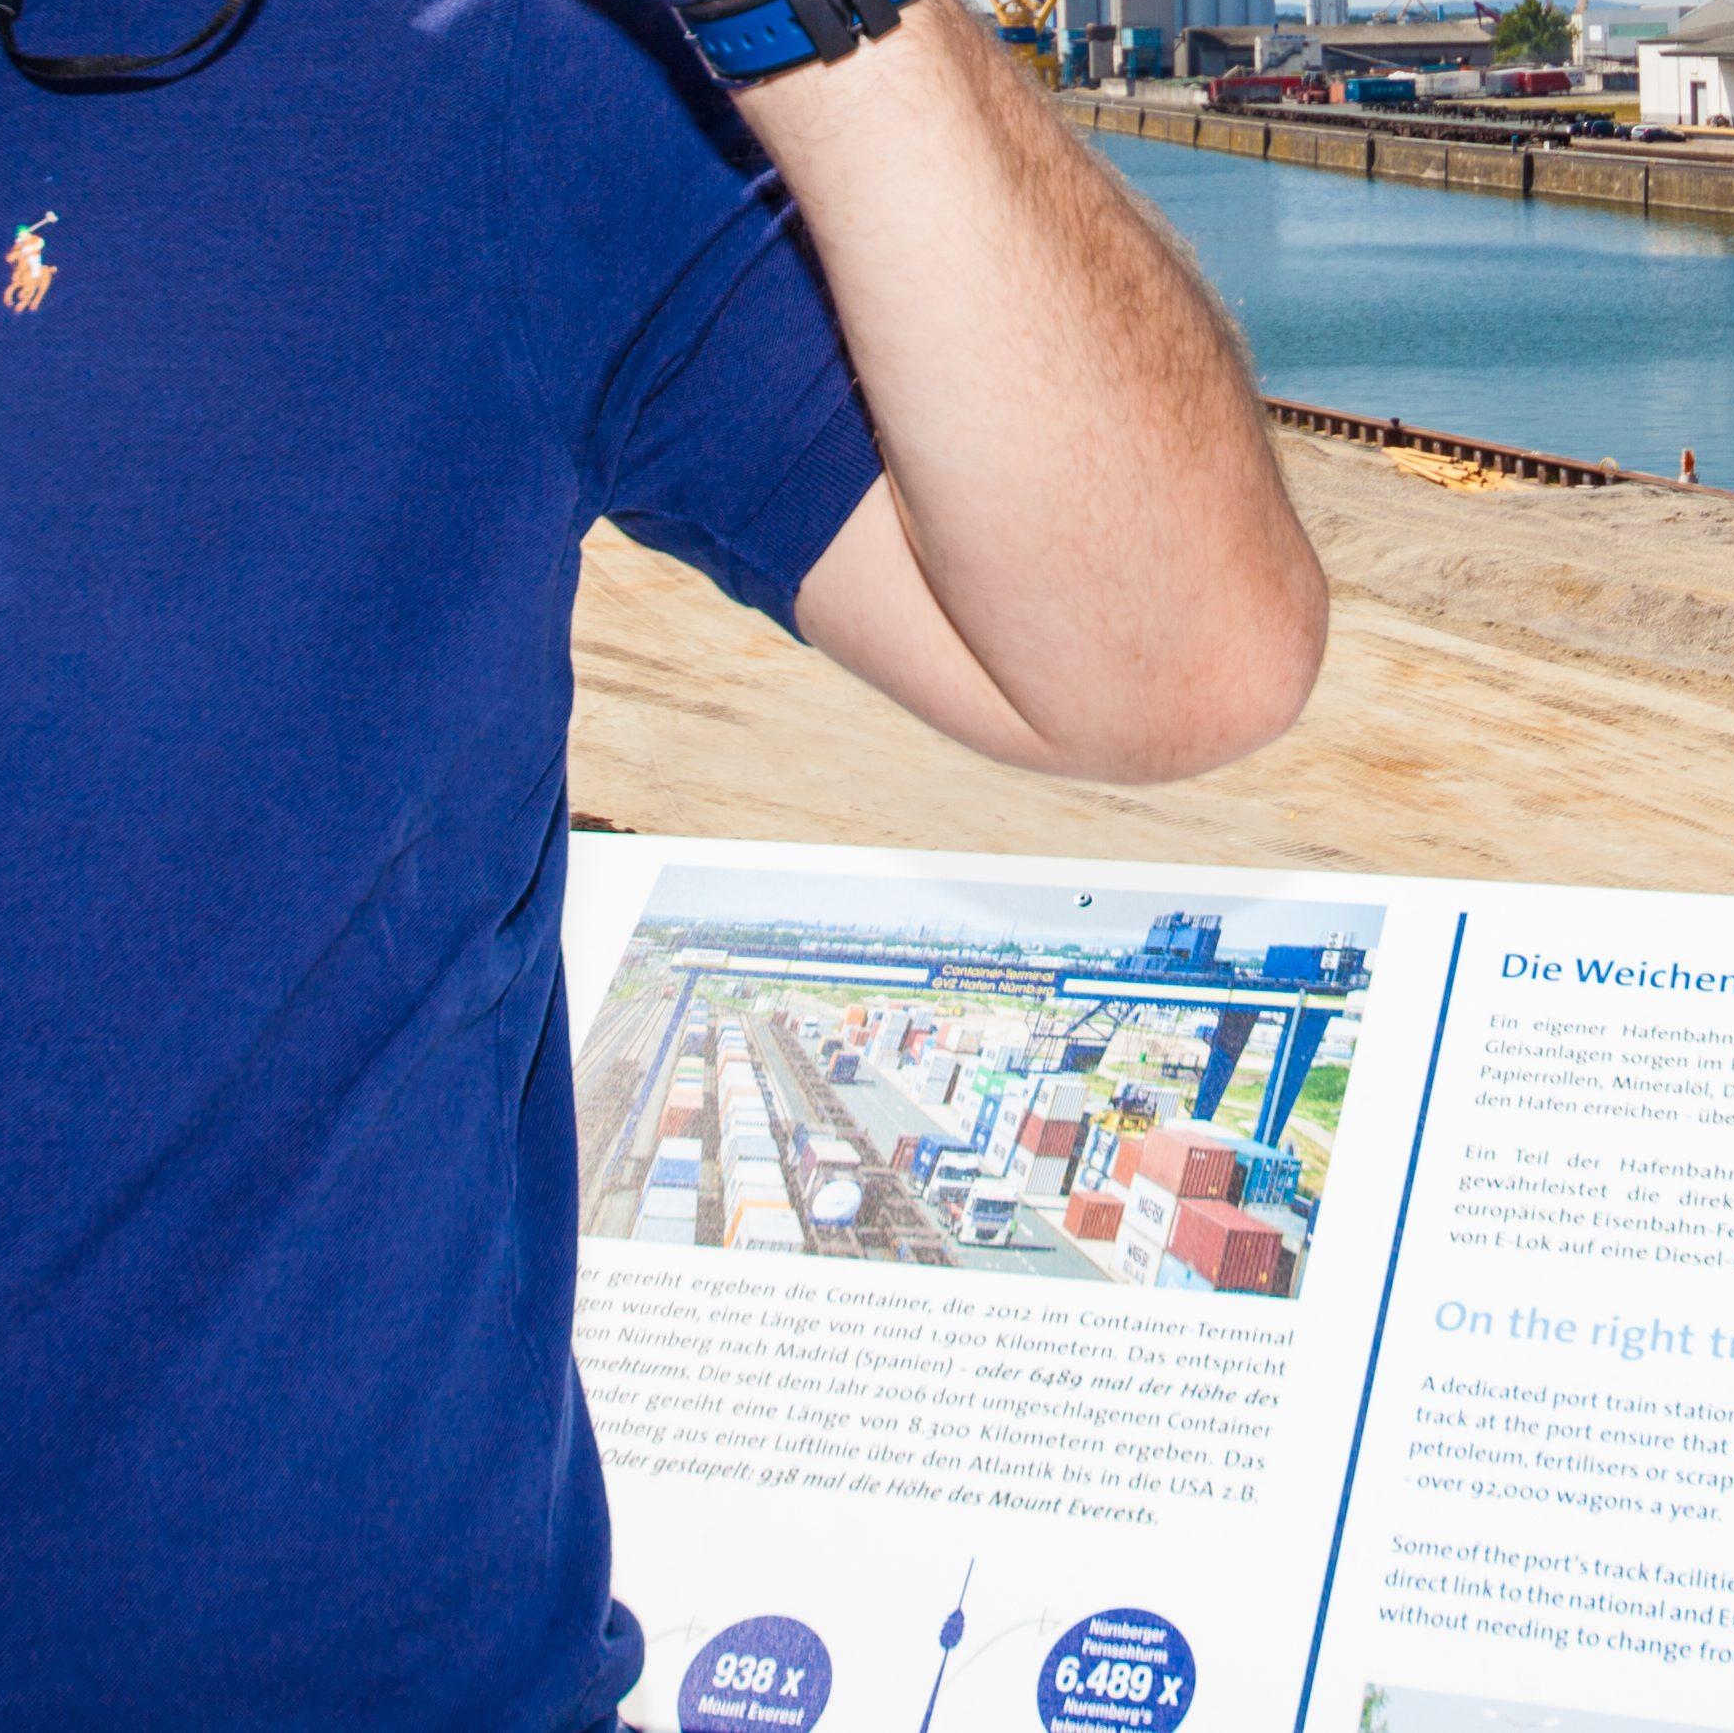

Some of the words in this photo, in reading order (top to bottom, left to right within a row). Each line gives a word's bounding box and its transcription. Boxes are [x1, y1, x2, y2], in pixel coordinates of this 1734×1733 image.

[1501, 953, 1563, 981] Die
[959, 979, 996, 992] Hafen
[1489, 1013, 1521, 1031] Ein
[1531, 1017, 1608, 1039] eigener
[1483, 1038, 1614, 1067] Gleisanlagen
[1620, 1052, 1689, 1073] sorgen
[1696, 1054, 1724, 1072] im
[1479, 1064, 1604, 1091] Papierrollen,
[1611, 1073, 1715, 1100] Mineralöl,
[1474, 1089, 1512, 1109] den
[1517, 1093, 1579, 1115] Hafen
[1583, 1102, 1680, 1123] erreichen
[1435, 1299, 1493, 1336] On
[1508, 1306, 1577, 1344] the
[1590, 1314, 1695, 1362] right
[601, 1448, 650, 1468] Oder
[649, 1456, 755, 1483] gestapelt:
[755, 1465, 801, 1489] 938
[801, 1470, 847, 1491] mal
[847, 1472, 882, 1495] die
[885, 1477, 944, 1502] Höhe
[946, 1483, 984, 1507] des
[987, 1489, 1064, 1515] Mount
[1066, 1497, 1159, 1526] Everests.
[1416, 1473, 1466, 1493] over
[1469, 1479, 1551, 1503] 92,000
[1555, 1489, 1644, 1515] wagons
[1649, 1499, 1664, 1516] a
[1668, 1501, 1724, 1523] year.
[1378, 1603, 1470, 1634] without
[1475, 1617, 1572, 1651] needing
[1575, 1625, 1602, 1651] to
[1604, 1628, 1697, 1666] change
[712, 1652, 777, 1694] 938
[779, 1667, 805, 1697] x
[1055, 1656, 1153, 1702] 6.489
[1157, 1675, 1183, 1706] x
[698, 1694, 747, 1719] Mount
[747, 1700, 805, 1726] Everest
